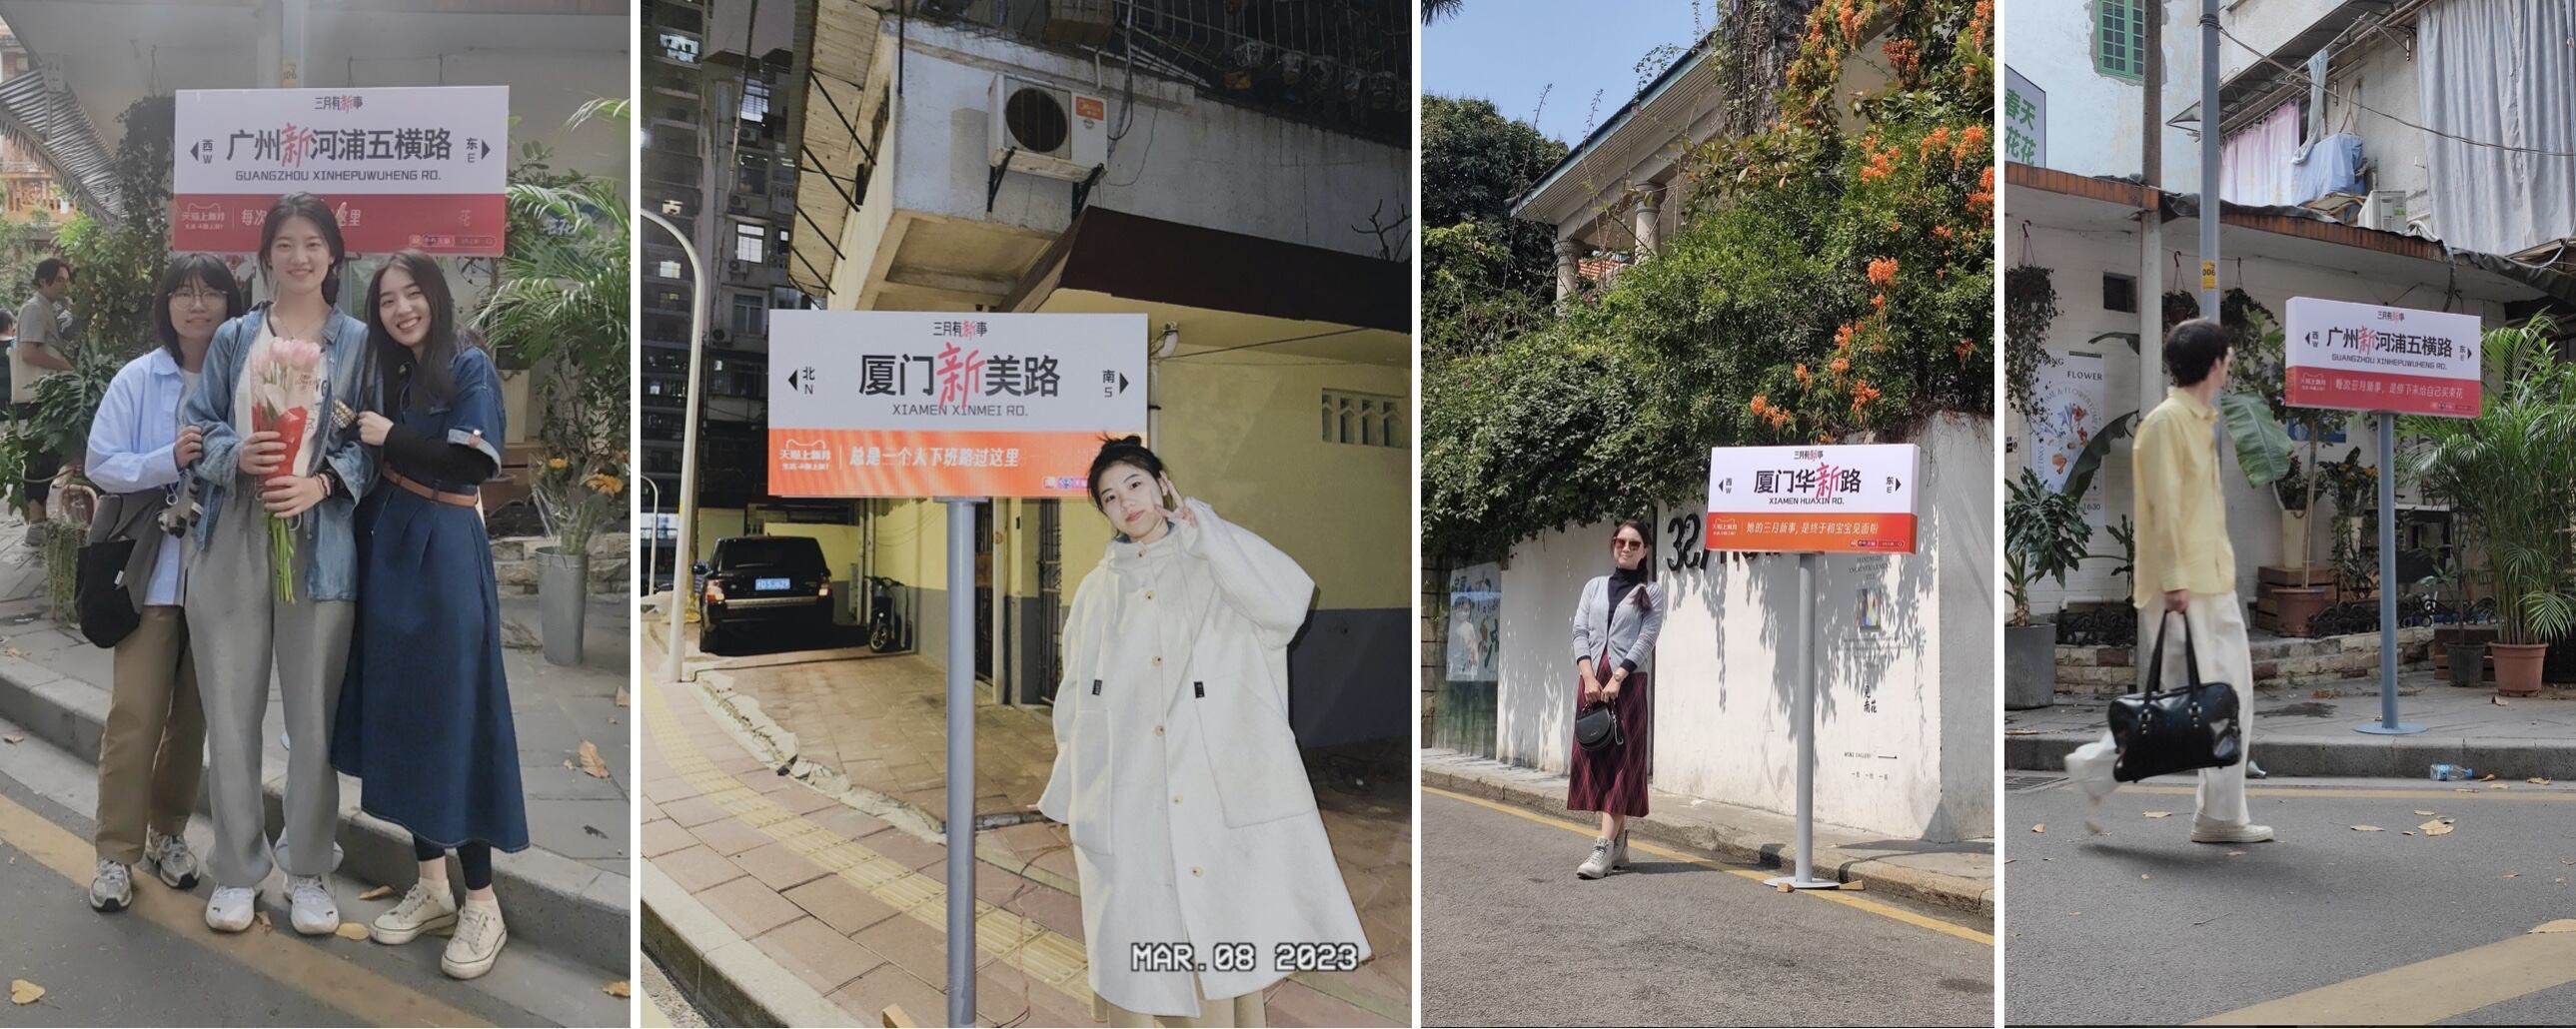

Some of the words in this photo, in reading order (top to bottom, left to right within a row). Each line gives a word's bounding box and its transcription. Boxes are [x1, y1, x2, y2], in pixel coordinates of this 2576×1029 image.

[315, 95, 363, 113] 三月有新事
[2004, 88, 2036, 130] 春天
[203, 139, 213, 151] 西
[226, 122, 452, 168] 广州新河浦五横路
[466, 138, 478, 150] 东
[2004, 126, 2036, 167] 花花
[203, 155, 213, 164] W
[468, 153, 475, 163] E
[236, 170, 309, 181] GUANGZHOU
[313, 170, 418, 181] XINHEPUWUHENG
[422, 170, 442, 181] RD.
[2377, 311, 2405, 324] 三月有新事
[933, 320, 987, 341] 三月有新事
[2327, 325, 2452, 358] 广州新河浦五横路
[2332, 354, 2375, 364] GUANGZHOU
[2376, 358, 2435, 370] XINHEPUWUHENG
[802, 367, 815, 381] 北
[859, 343, 1061, 409] 厦门新美路
[1102, 370, 1115, 384] 南
[2067, 371, 2103, 381] FLOWER
[804, 384, 813, 395] N
[1104, 387, 1112, 398] S
[892, 404, 947, 416] XIAMEN
[951, 405, 1002, 417] XINMEI
[1006, 406, 1028, 417] RD.
[1794, 450, 1824, 462] 三月有新事
[1726, 478, 1733, 487] 西
[1754, 463, 1862, 500] 厦门华新路
[1886, 477, 1894, 486] 东
